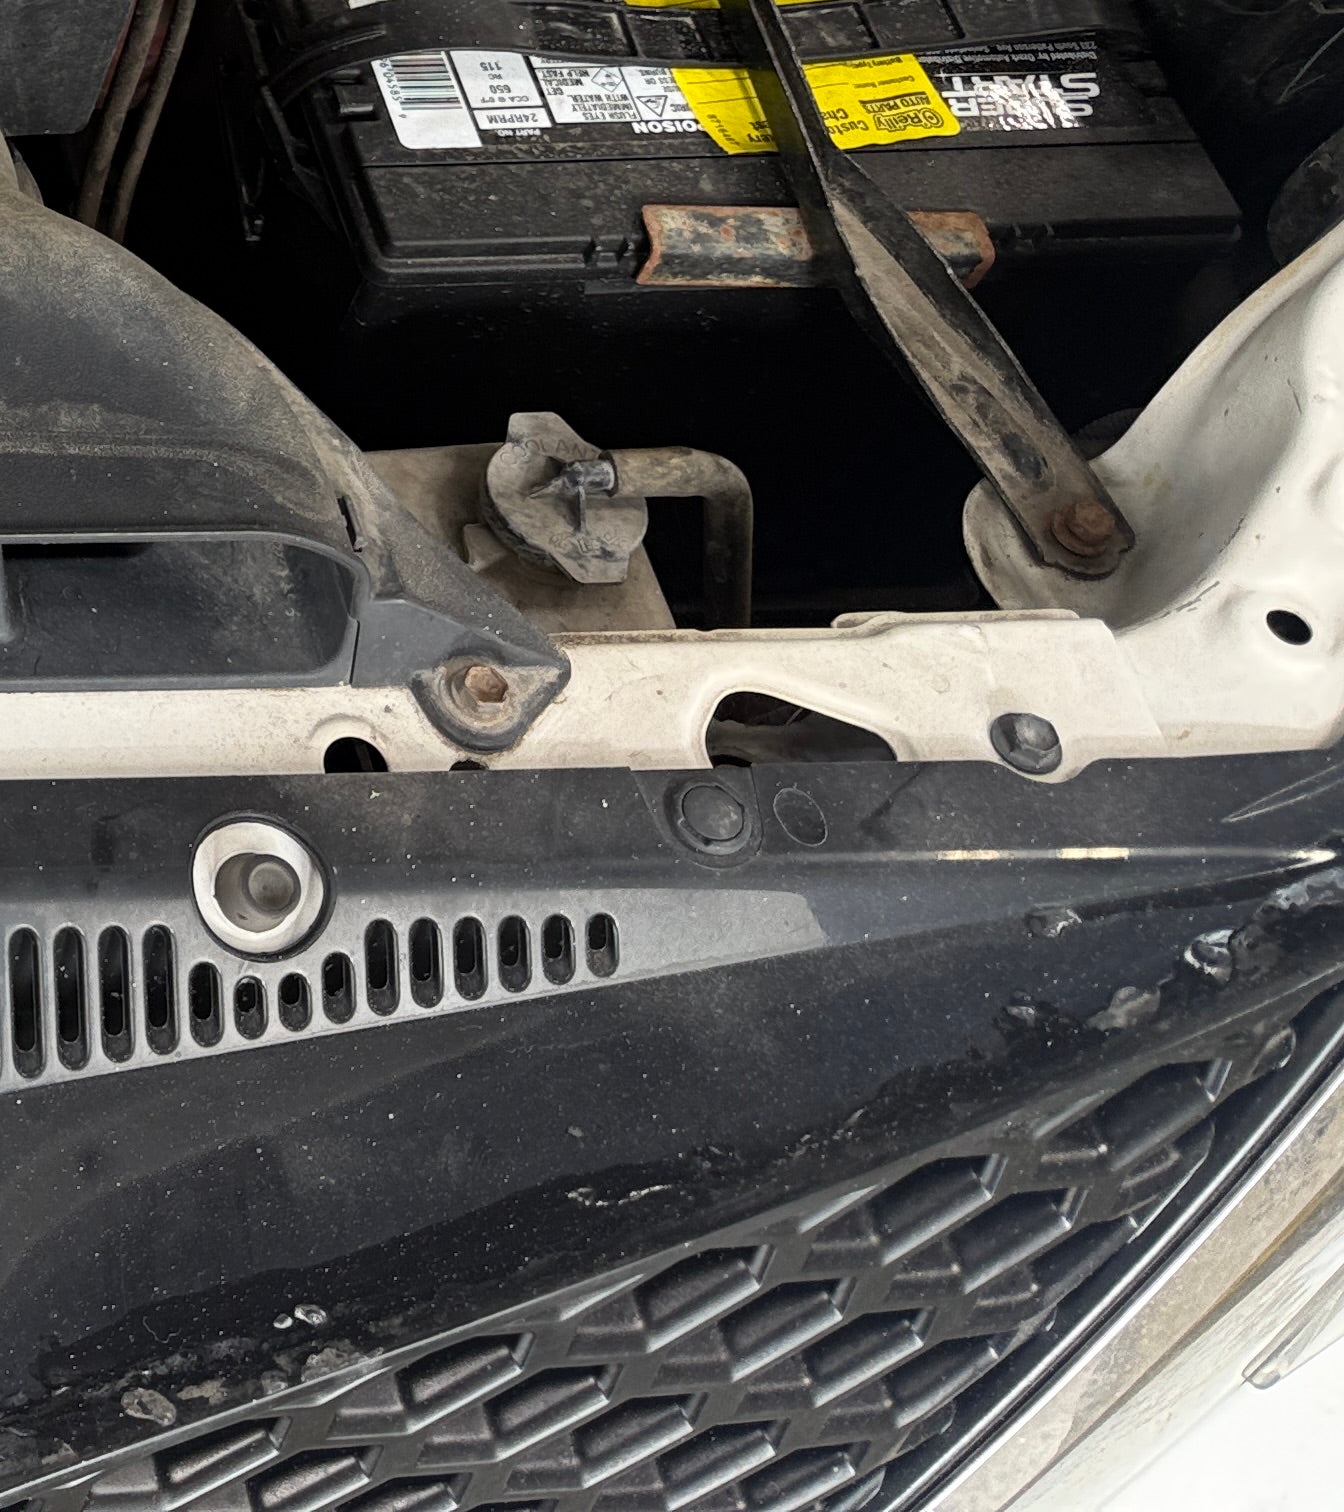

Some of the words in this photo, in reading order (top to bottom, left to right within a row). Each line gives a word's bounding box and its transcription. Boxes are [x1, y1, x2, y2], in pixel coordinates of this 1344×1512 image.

[479, 61, 501, 71] 115
[540, 78, 583, 86] MEDICAL
[488, 84, 511, 94] 650
[900, 94, 930, 108] AUTO
[948, 95, 1093, 116] SER
[571, 103, 632, 111] IMMEDIATELY
[485, 112, 537, 123] 24RPRM
[582, 112, 605, 120] EYES
[608, 111, 637, 119] FLUSH
[873, 109, 943, 131] O'Reilly
